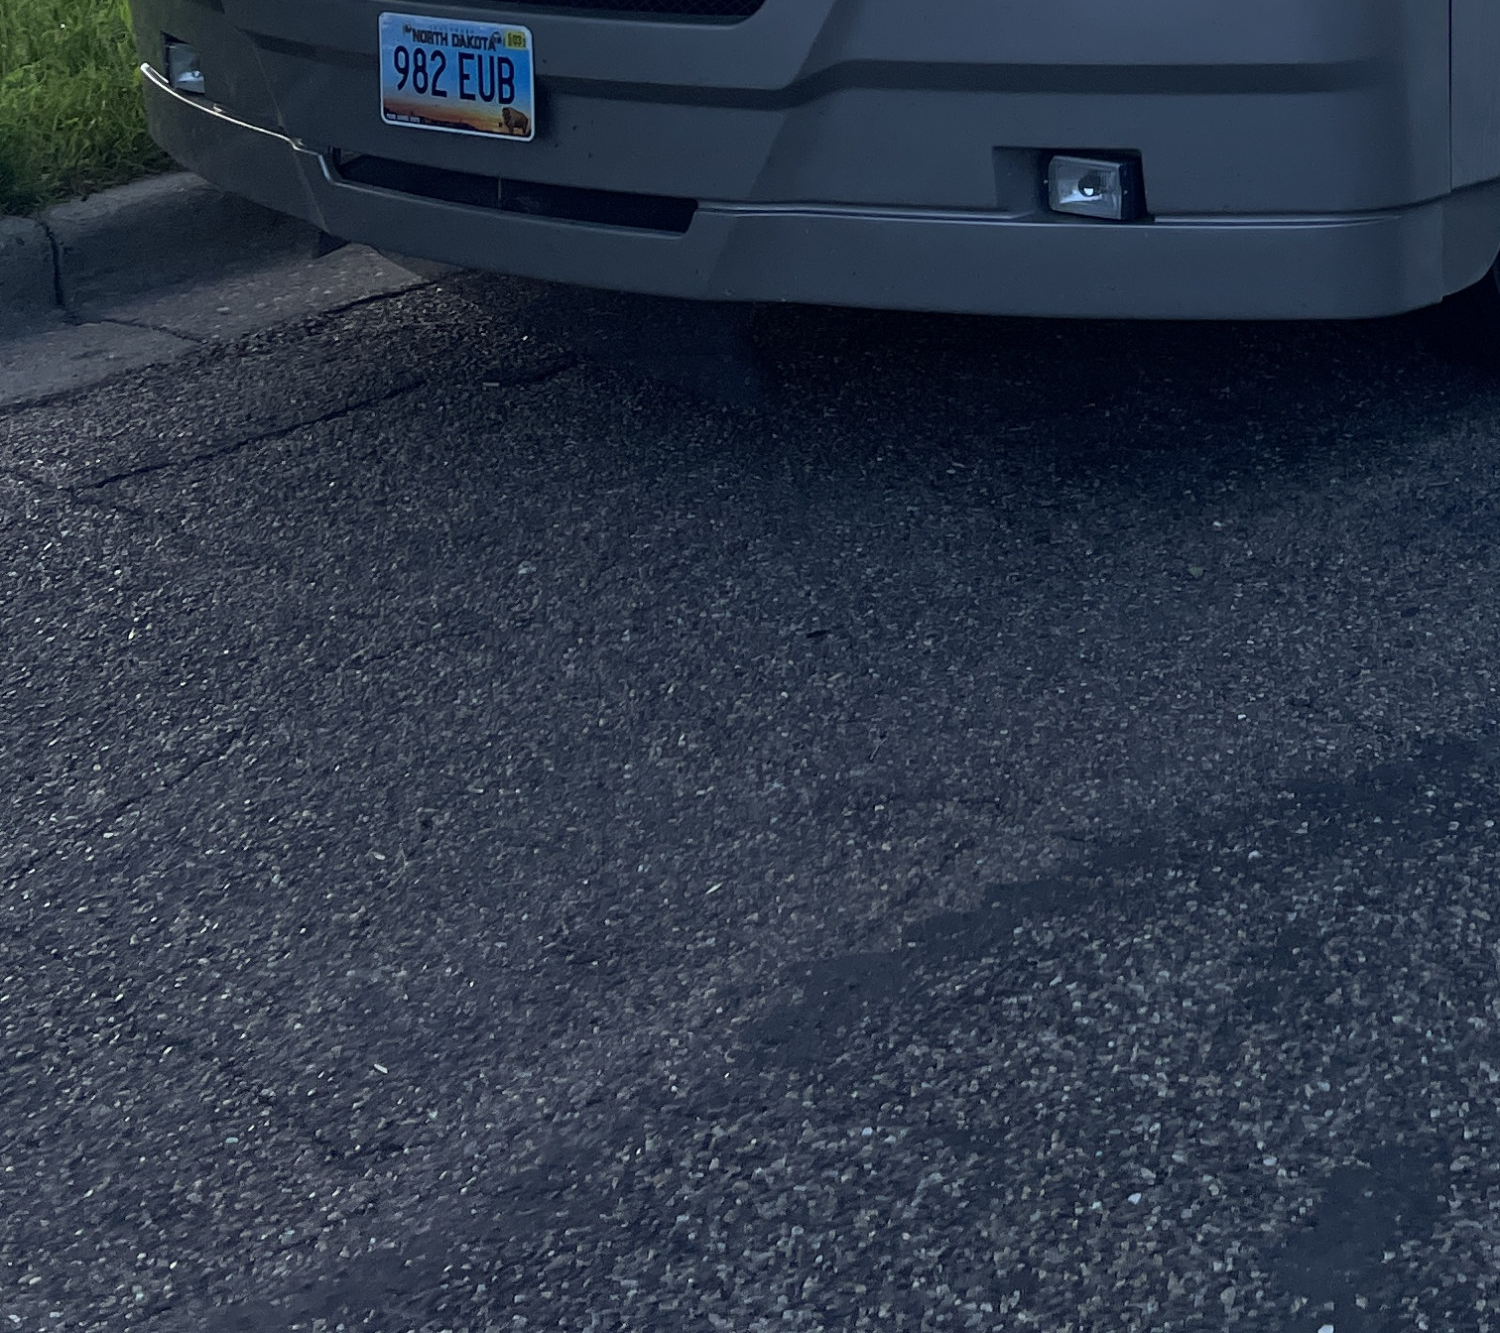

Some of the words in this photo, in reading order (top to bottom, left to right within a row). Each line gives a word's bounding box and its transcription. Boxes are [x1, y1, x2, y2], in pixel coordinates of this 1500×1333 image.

[412, 29, 448, 47] NORTH
[452, 33, 496, 51] DAKOTA
[393, 45, 448, 98] 982
[458, 52, 515, 105] EUB
